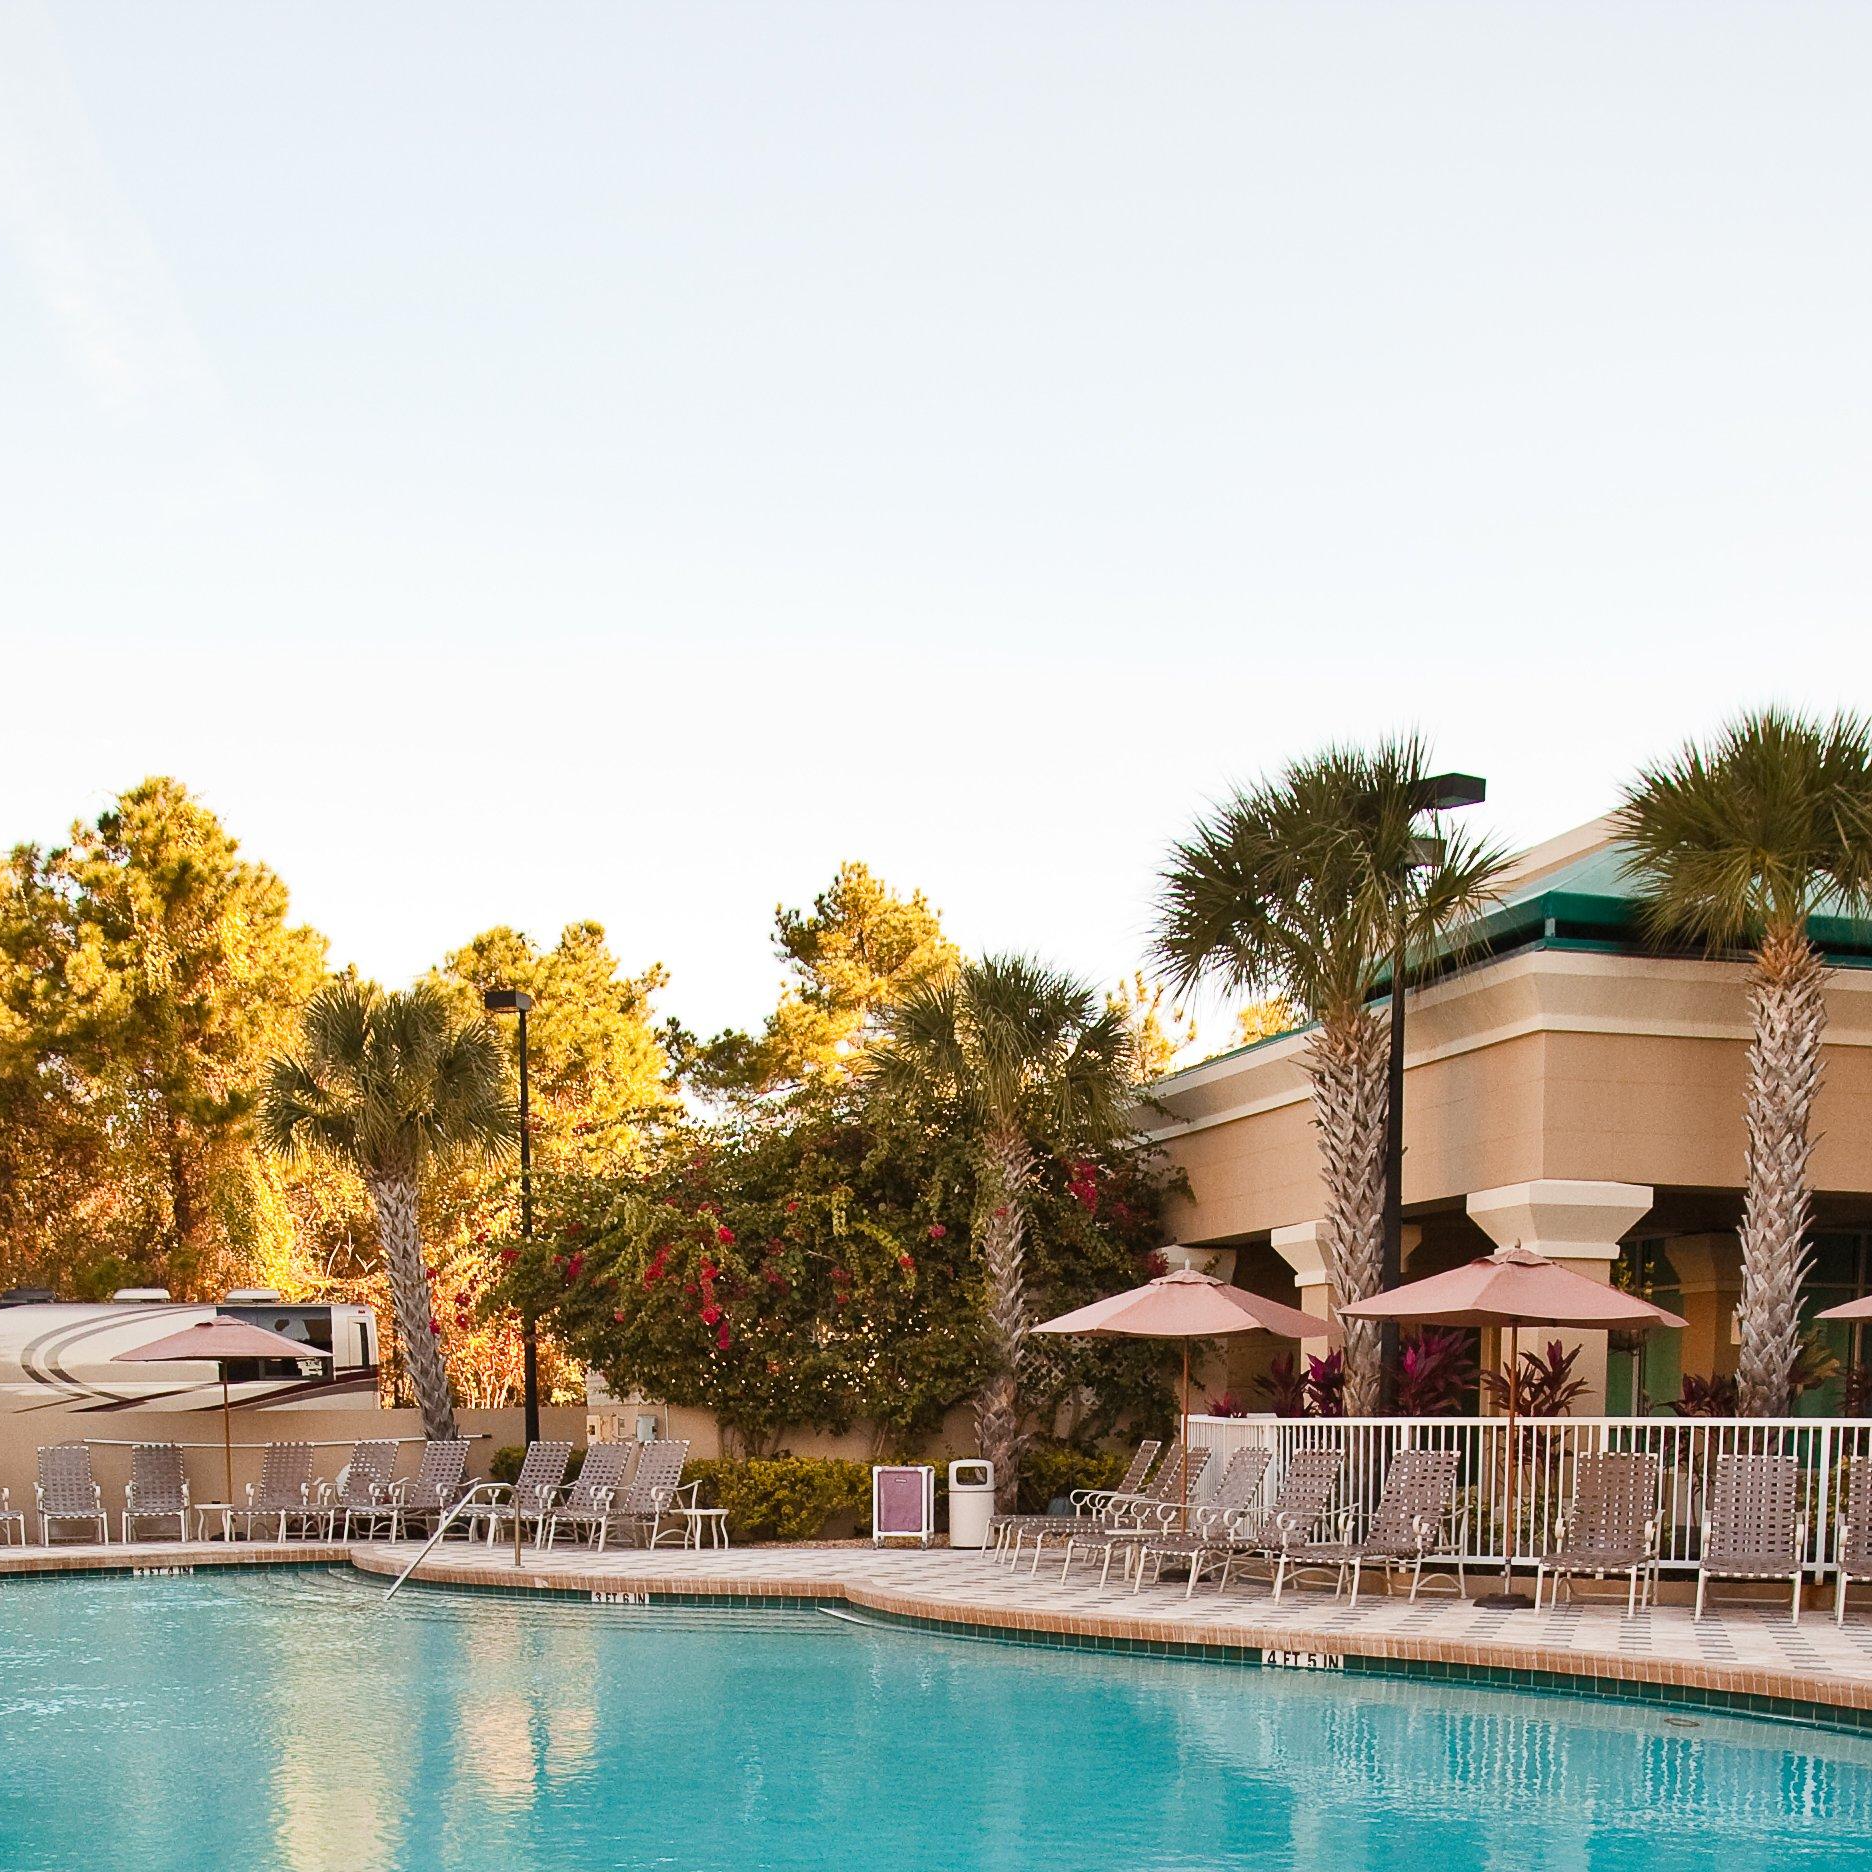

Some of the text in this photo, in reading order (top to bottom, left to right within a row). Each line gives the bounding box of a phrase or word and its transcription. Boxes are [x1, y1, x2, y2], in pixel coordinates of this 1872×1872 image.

[605, 1592, 618, 1603] FT
[634, 1592, 646, 1605] IN
[1268, 1650, 1339, 1668] 4 FT 5 IN
